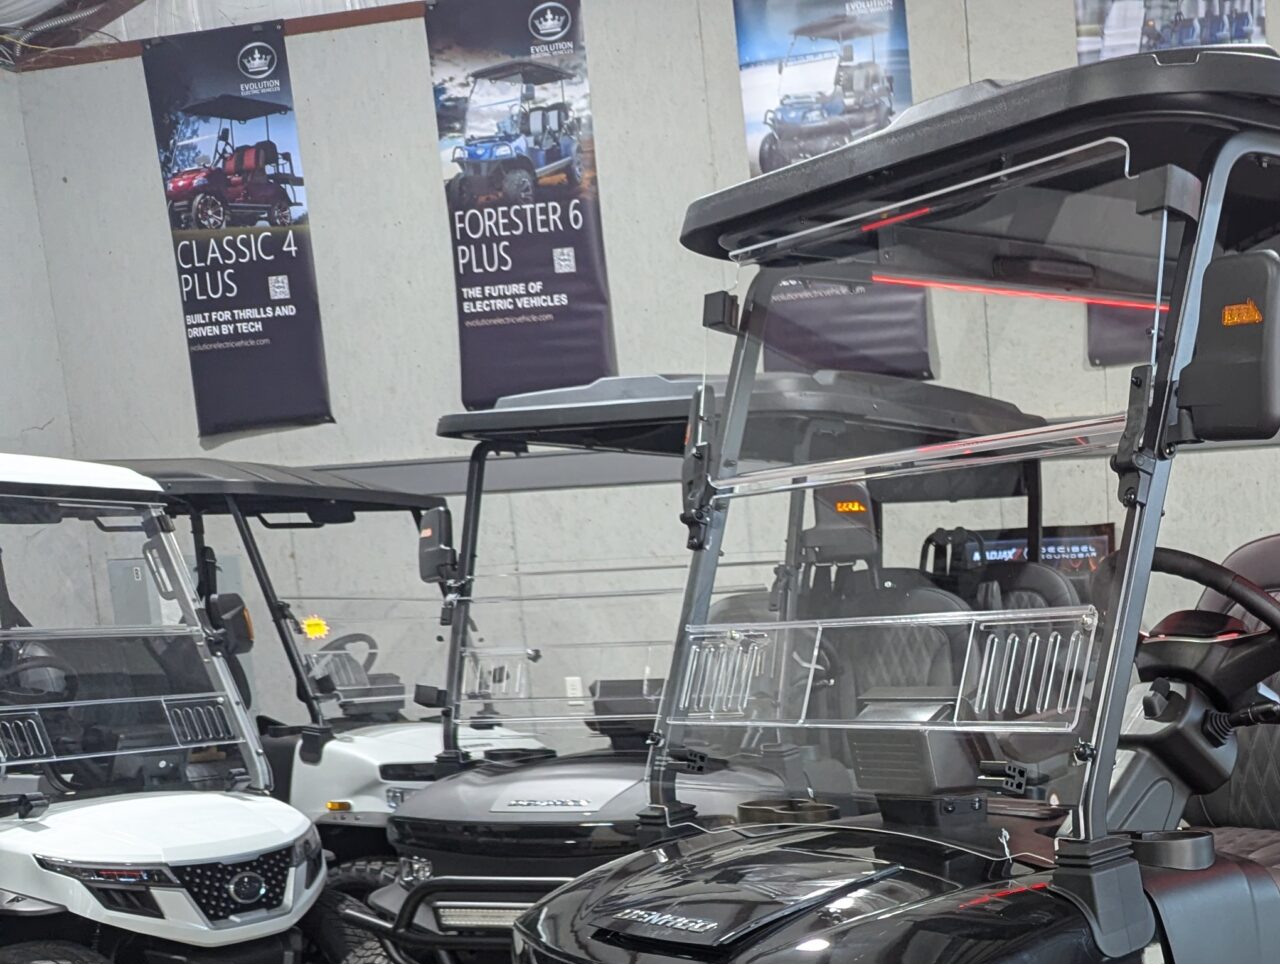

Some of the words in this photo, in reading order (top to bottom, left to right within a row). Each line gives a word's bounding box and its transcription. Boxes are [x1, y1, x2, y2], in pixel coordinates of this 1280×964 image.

[530, 41, 574, 54] EVOLUTION
[240, 79, 280, 91] EVOLUTION
[454, 201, 564, 240] FORESTER
[568, 199, 583, 230] 6
[177, 231, 275, 269] CLASSIC
[282, 229, 298, 258] 4
[457, 241, 513, 275] PLUS
[180, 269, 238, 302] PLUS
[461, 286, 483, 299] THE
[484, 283, 526, 297] FUTURE
[527, 281, 544, 294] OF
[463, 298, 514, 313] ELECTRIC
[515, 293, 568, 308] VEHICLES
[185, 312, 210, 325] BUILT
[211, 310, 232, 323] FOR
[232, 306, 274, 321] THRILLS
[274, 304, 297, 317] AND
[187, 325, 220, 339] DRIVEN
[221, 323, 235, 335] BY
[236, 321, 263, 334] TECH
